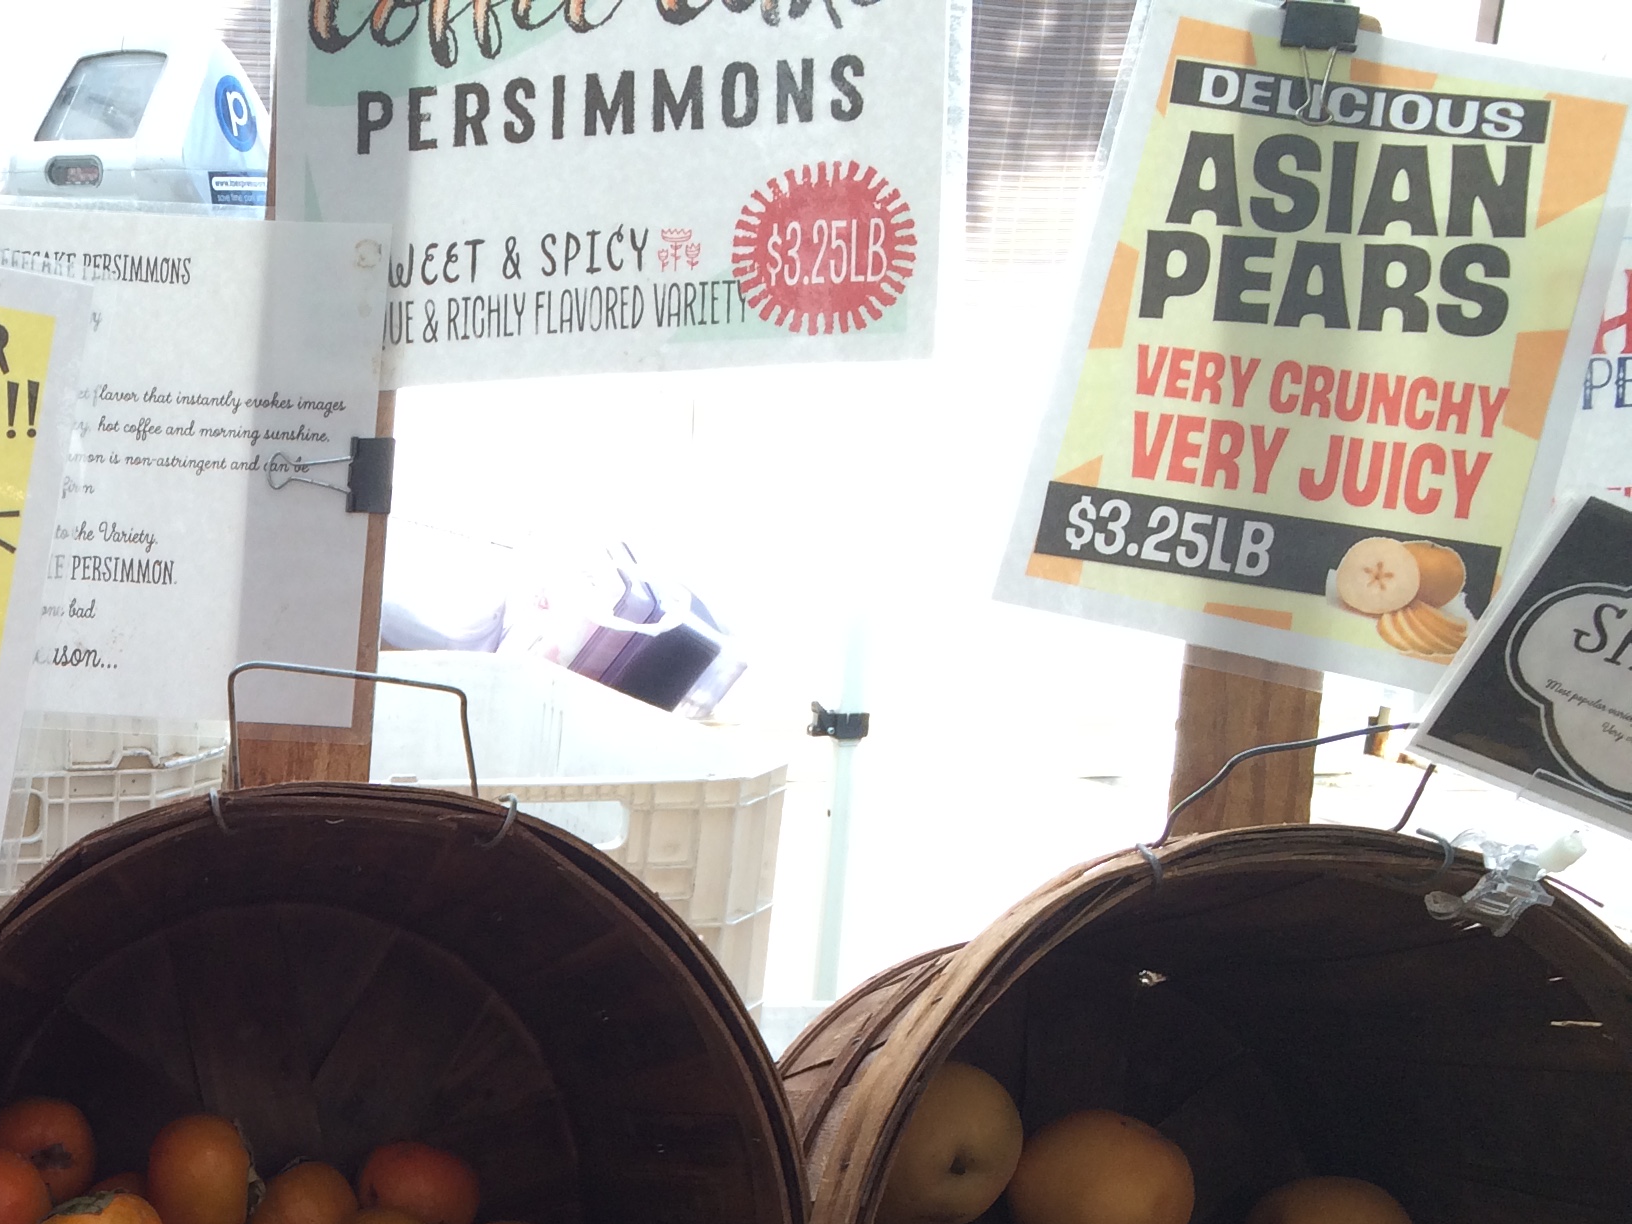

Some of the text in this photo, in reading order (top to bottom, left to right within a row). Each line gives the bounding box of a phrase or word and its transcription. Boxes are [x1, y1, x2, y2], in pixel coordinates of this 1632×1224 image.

[357, 54, 865, 155] PERSIMMONS
[1197, 66, 1525, 139] DELICIOUS
[1165, 130, 1533, 239] ASIAN
[83, 253, 191, 285] PERSIMMONS
[388, 223, 648, 288] WEET & SPICY
[766, 217, 888, 286] $3.25LB
[1138, 228, 1511, 337] PEARS
[423, 299, 438, 343] &
[447, 292, 526, 341] RICHLY
[535, 285, 644, 335] FLAVORED
[654, 279, 747, 328] VARIETY
[144, 388, 172, 404] that
[176, 389, 241, 414] instantly
[245, 392, 293, 409] evokes
[298, 396, 346, 418] images
[1133, 342, 1511, 439] VERY CRUNCHY
[98, 416, 120, 432] hot
[123, 417, 163, 441] coffee
[165, 419, 195, 436] and
[199, 427, 261, 446] morning
[263, 426, 330, 443] sunshine.
[109, 451, 120, 465] is
[125, 453, 227, 476] non-astringent
[230, 453, 260, 472] and
[1130, 410, 1493, 521] VERY JUICY
[99, 521, 158, 553] Variety.
[1064, 494, 1276, 579] $3.25LB
[70, 555, 178, 585] PERSIMMON.
[69, 598, 96, 618] bad
